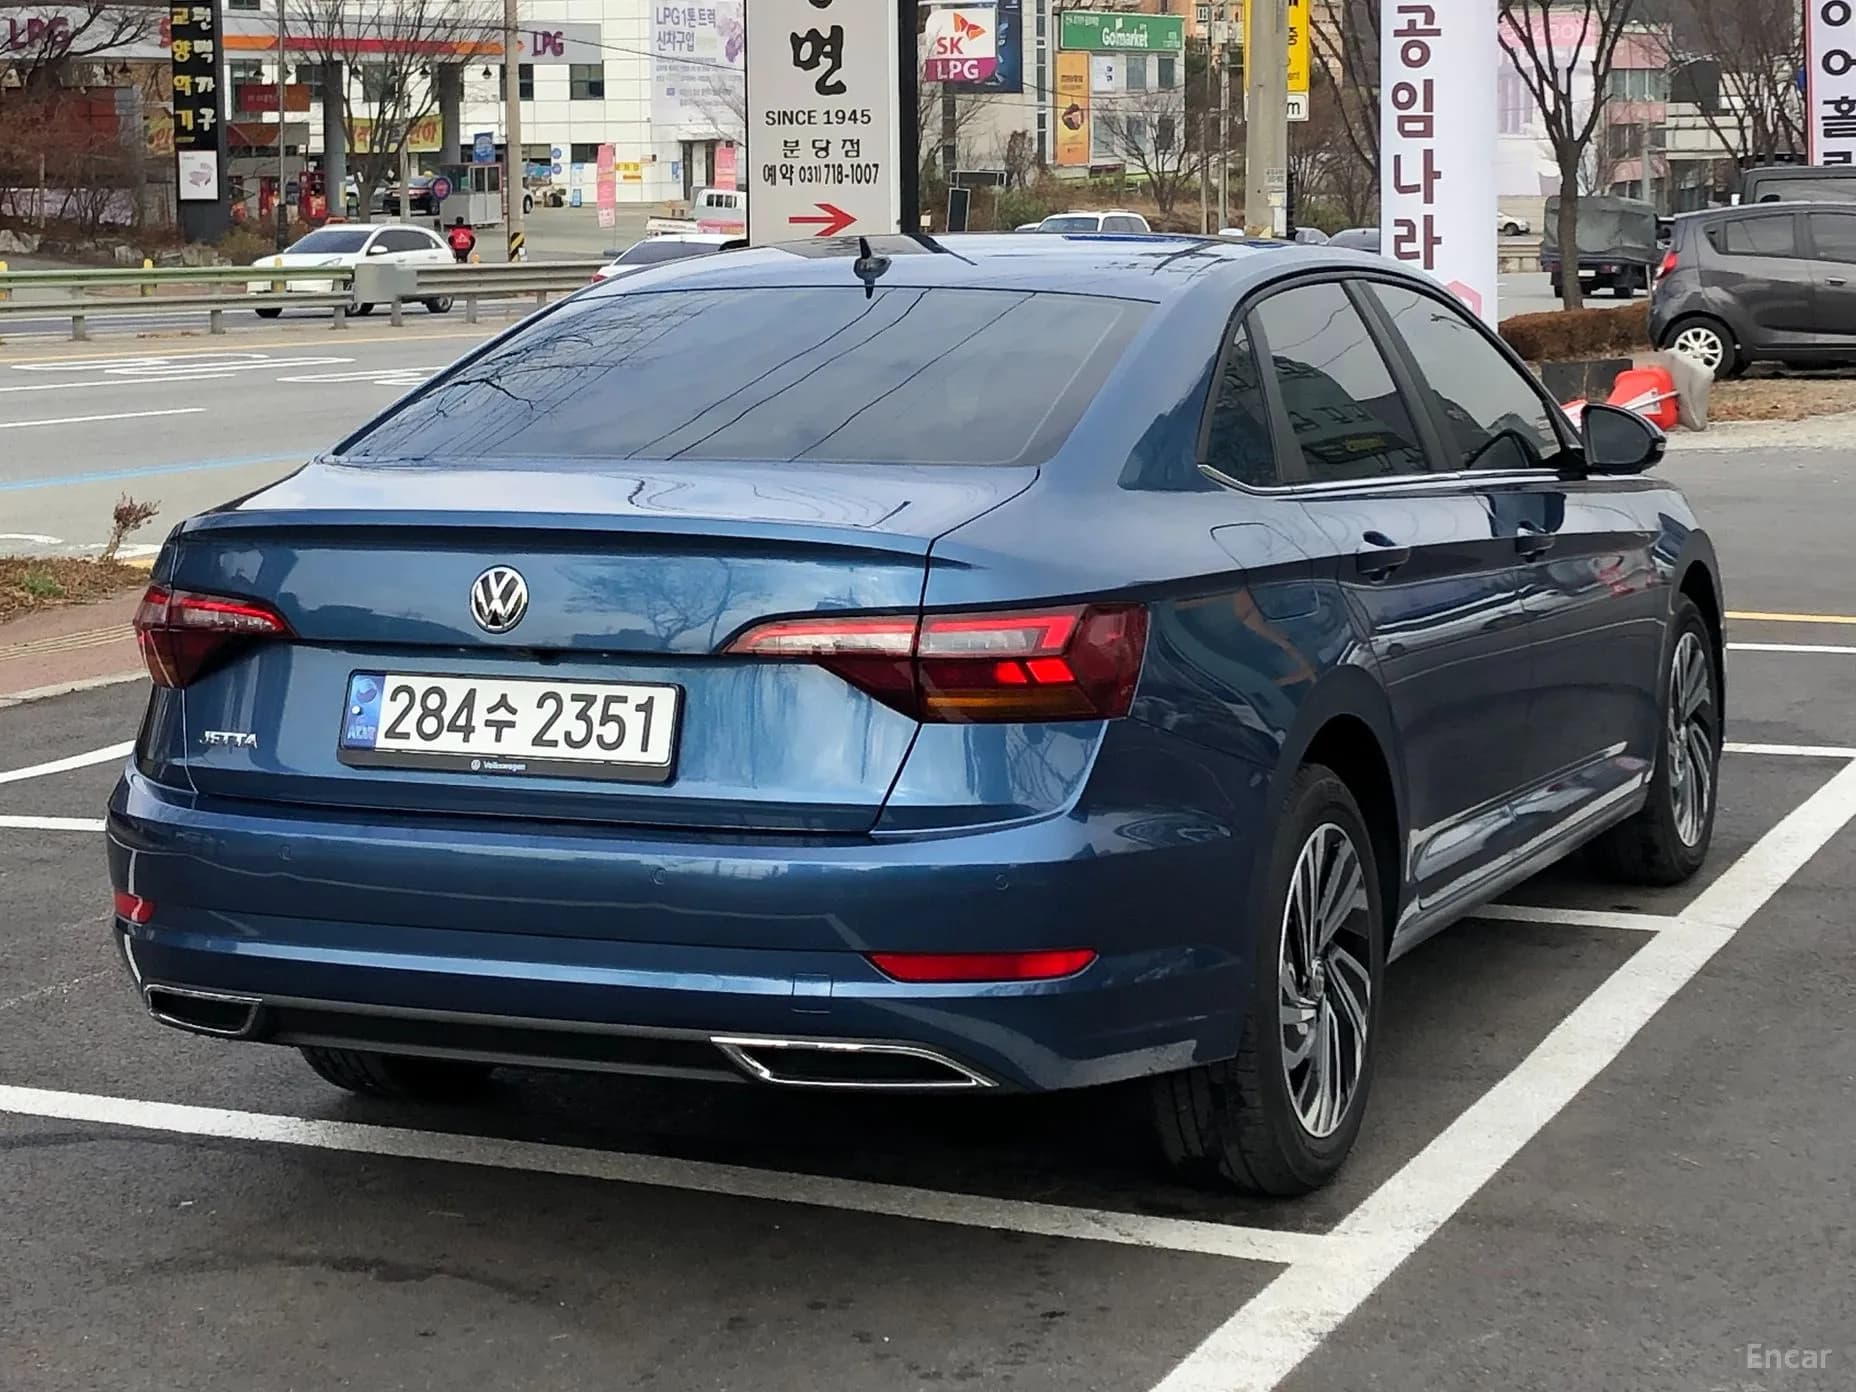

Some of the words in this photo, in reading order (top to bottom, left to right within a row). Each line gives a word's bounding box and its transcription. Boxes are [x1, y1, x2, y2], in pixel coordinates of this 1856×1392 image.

[9, 16, 71, 49] LPG
[532, 30, 564, 56] LPG
[789, 0, 847, 96] 면
[936, 36, 964, 55] SK
[936, 60, 980, 80] LPG
[765, 110, 817, 126] SINCE
[823, 109, 872, 125] 1945
[1392, 5, 1443, 270] 공임나라
[762, 164, 795, 187] 예약
[531, 691, 656, 753] 2351
[199, 730, 258, 749] JETTA
